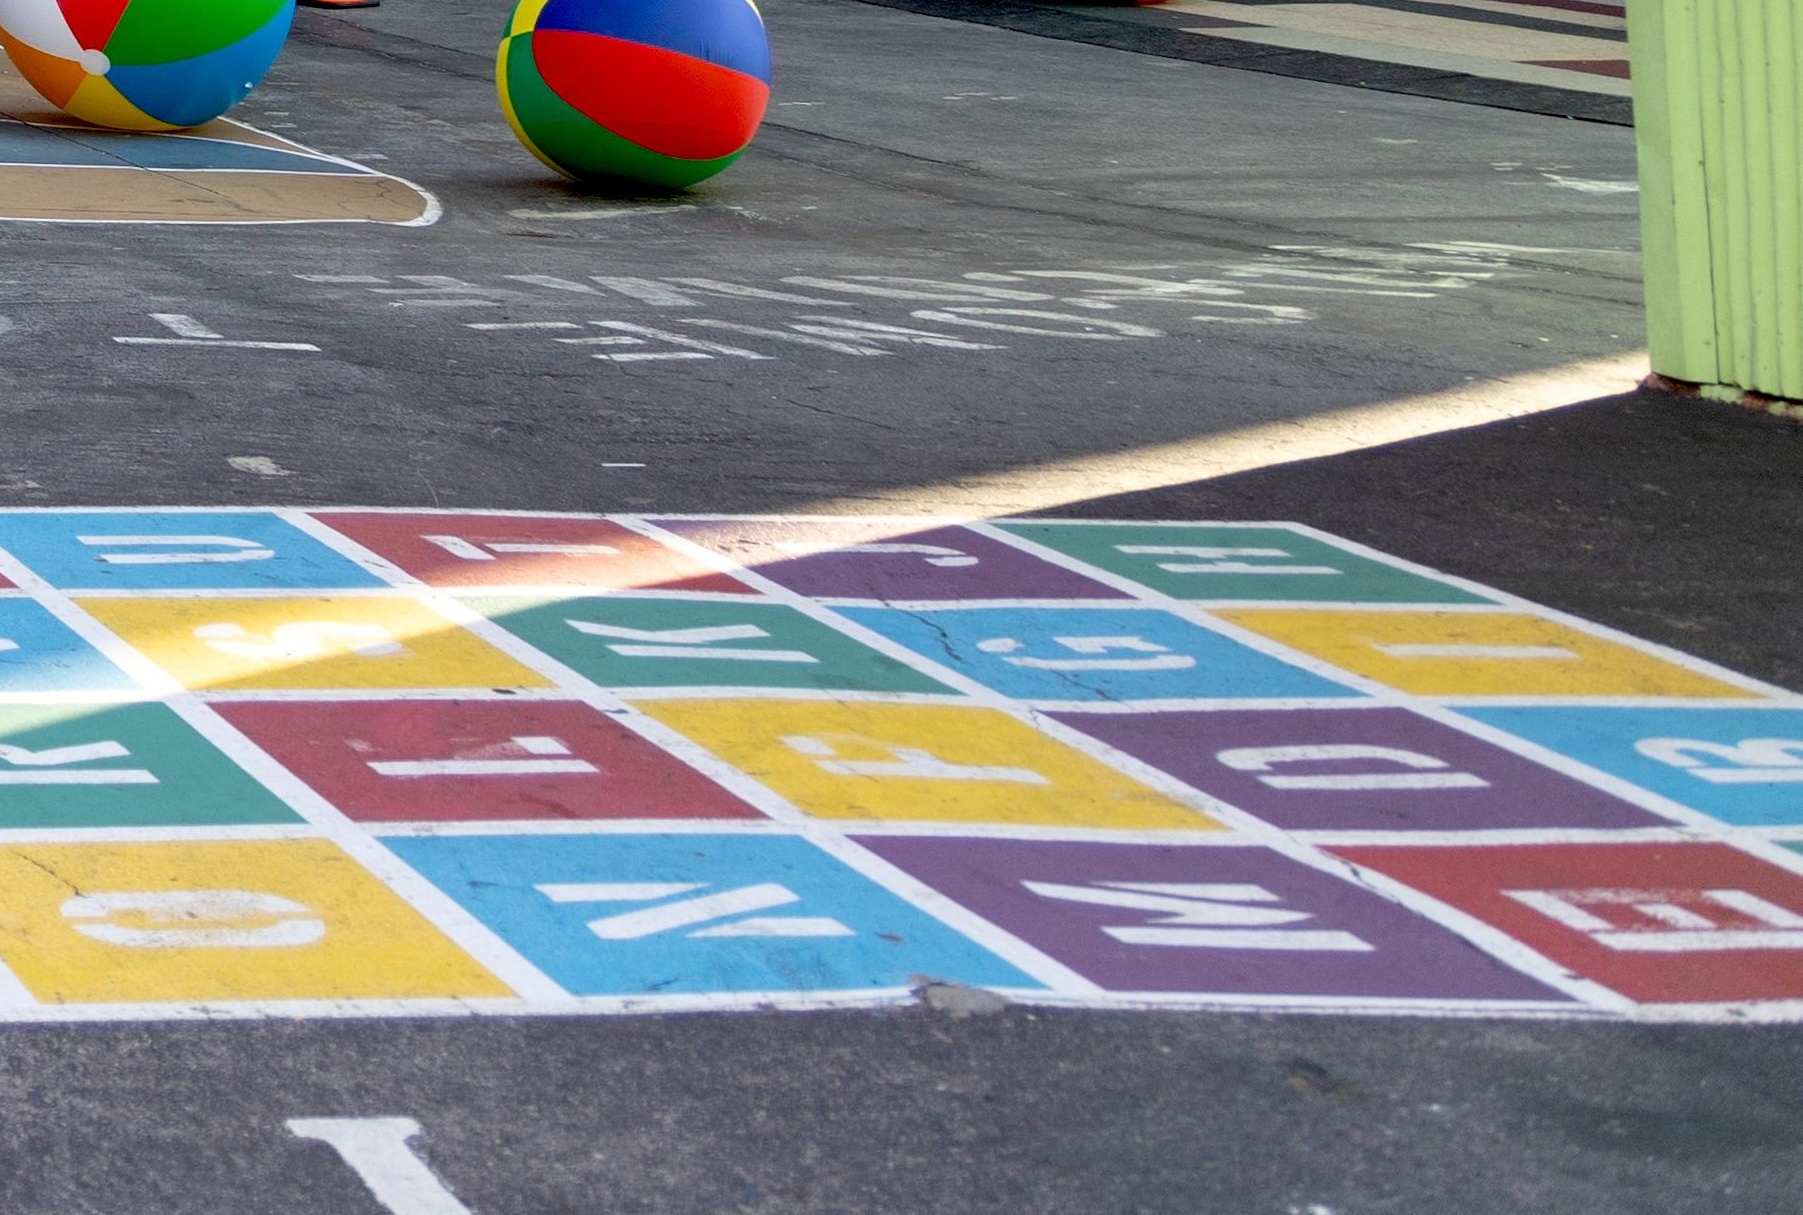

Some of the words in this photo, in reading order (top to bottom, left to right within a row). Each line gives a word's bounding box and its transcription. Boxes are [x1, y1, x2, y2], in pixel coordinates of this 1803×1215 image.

[76, 534, 276, 565] U
[420, 535, 620, 560] T
[1116, 544, 1340, 575] H
[195, 621, 402, 658] S
[566, 619, 819, 662] K
[978, 634, 1196, 672] G
[1373, 643, 1582, 660] I
[366, 735, 601, 778] L
[780, 734, 1051, 786] F
[1214, 743, 1491, 789] D
[60, 889, 326, 949] O
[534, 884, 855, 939] N
[1022, 880, 1375, 951] M
[1500, 889, 1803, 952] E
